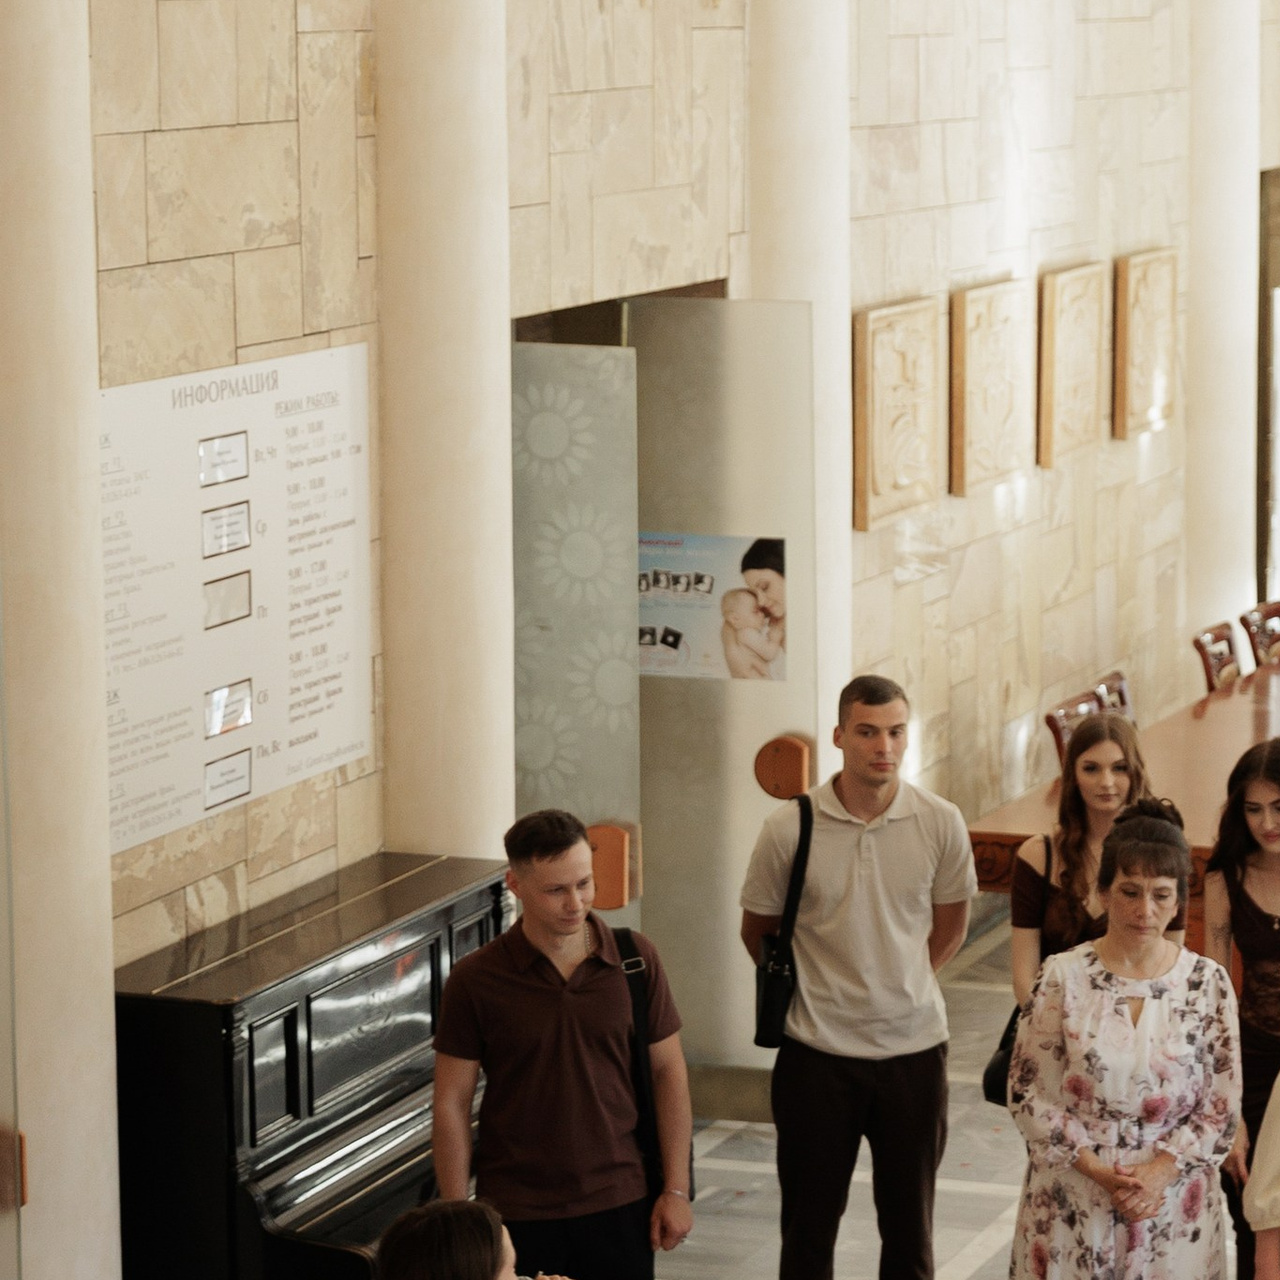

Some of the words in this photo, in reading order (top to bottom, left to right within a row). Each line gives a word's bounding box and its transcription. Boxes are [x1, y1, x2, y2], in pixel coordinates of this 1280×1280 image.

[172, 370, 280, 410] ИНФОРМАЦИЯ
[275, 398, 304, 416] РЕЖИМ
[306, 391, 339, 409] РАБОТЫ:
[255, 519, 268, 537] Ср
[256, 688, 269, 705] Сб
